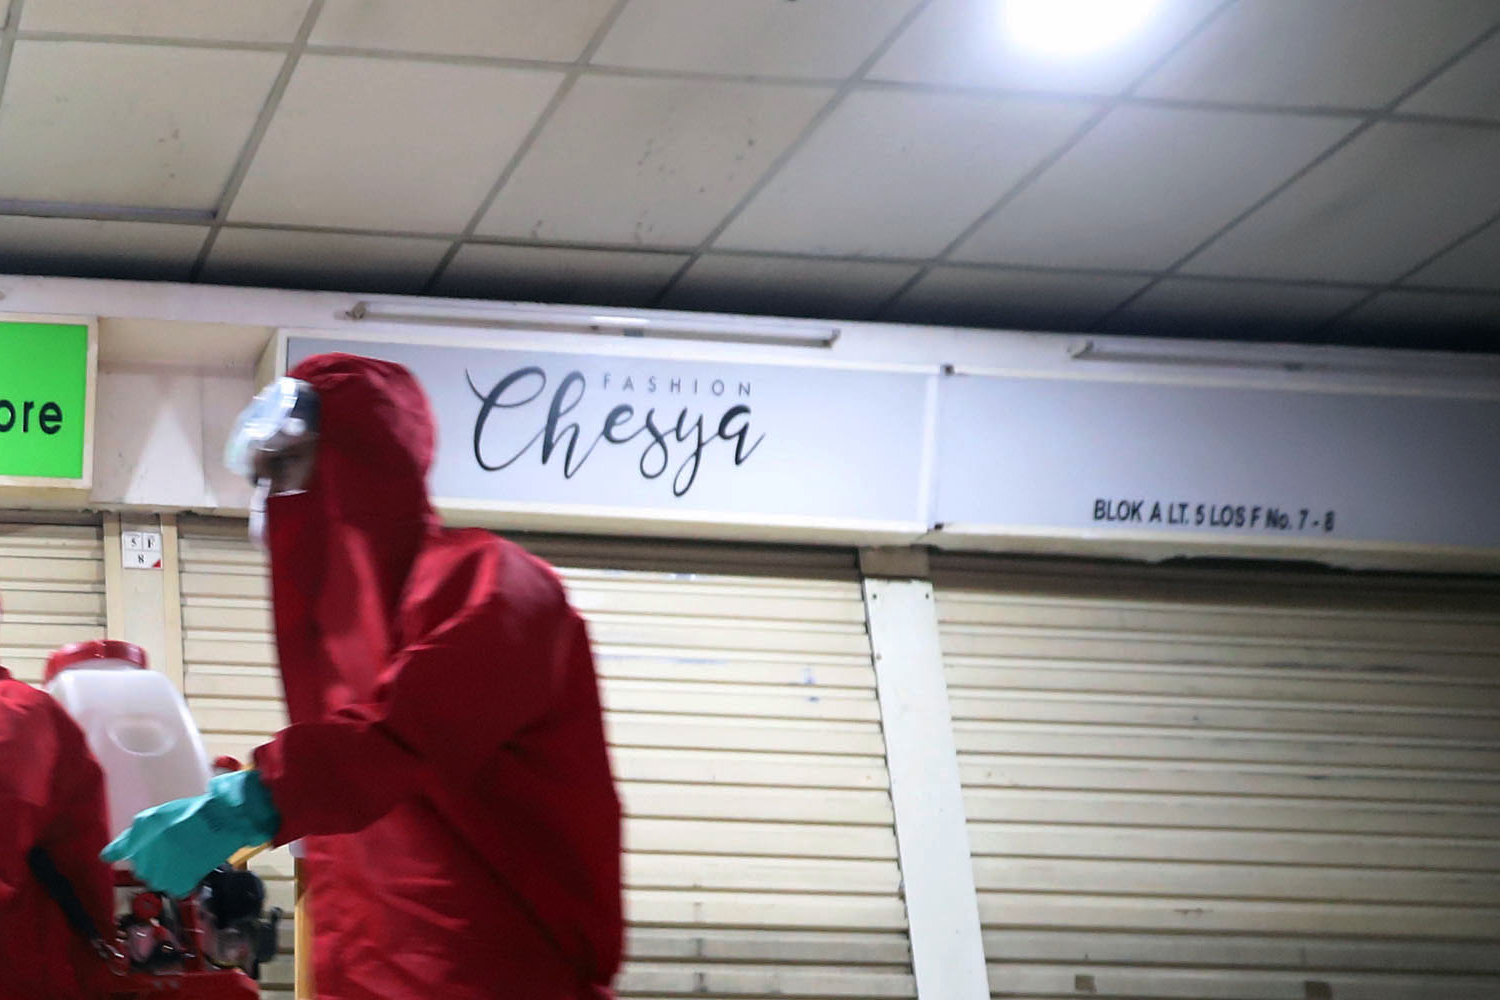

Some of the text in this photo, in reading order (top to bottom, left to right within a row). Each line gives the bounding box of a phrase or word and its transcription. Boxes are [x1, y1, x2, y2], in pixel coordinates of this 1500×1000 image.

[602, 371, 754, 398] FASHION
[464, 365, 765, 498] Chesya
[1093, 499, 1143, 522] BLOK
[1149, 501, 1163, 523] A
[1168, 502, 1189, 525] LT.
[1195, 504, 1206, 526] 5
[1209, 504, 1246, 528] LOS
[1250, 506, 1262, 527] F
[1265, 508, 1293, 531] No.
[1299, 508, 1310, 531] 7
